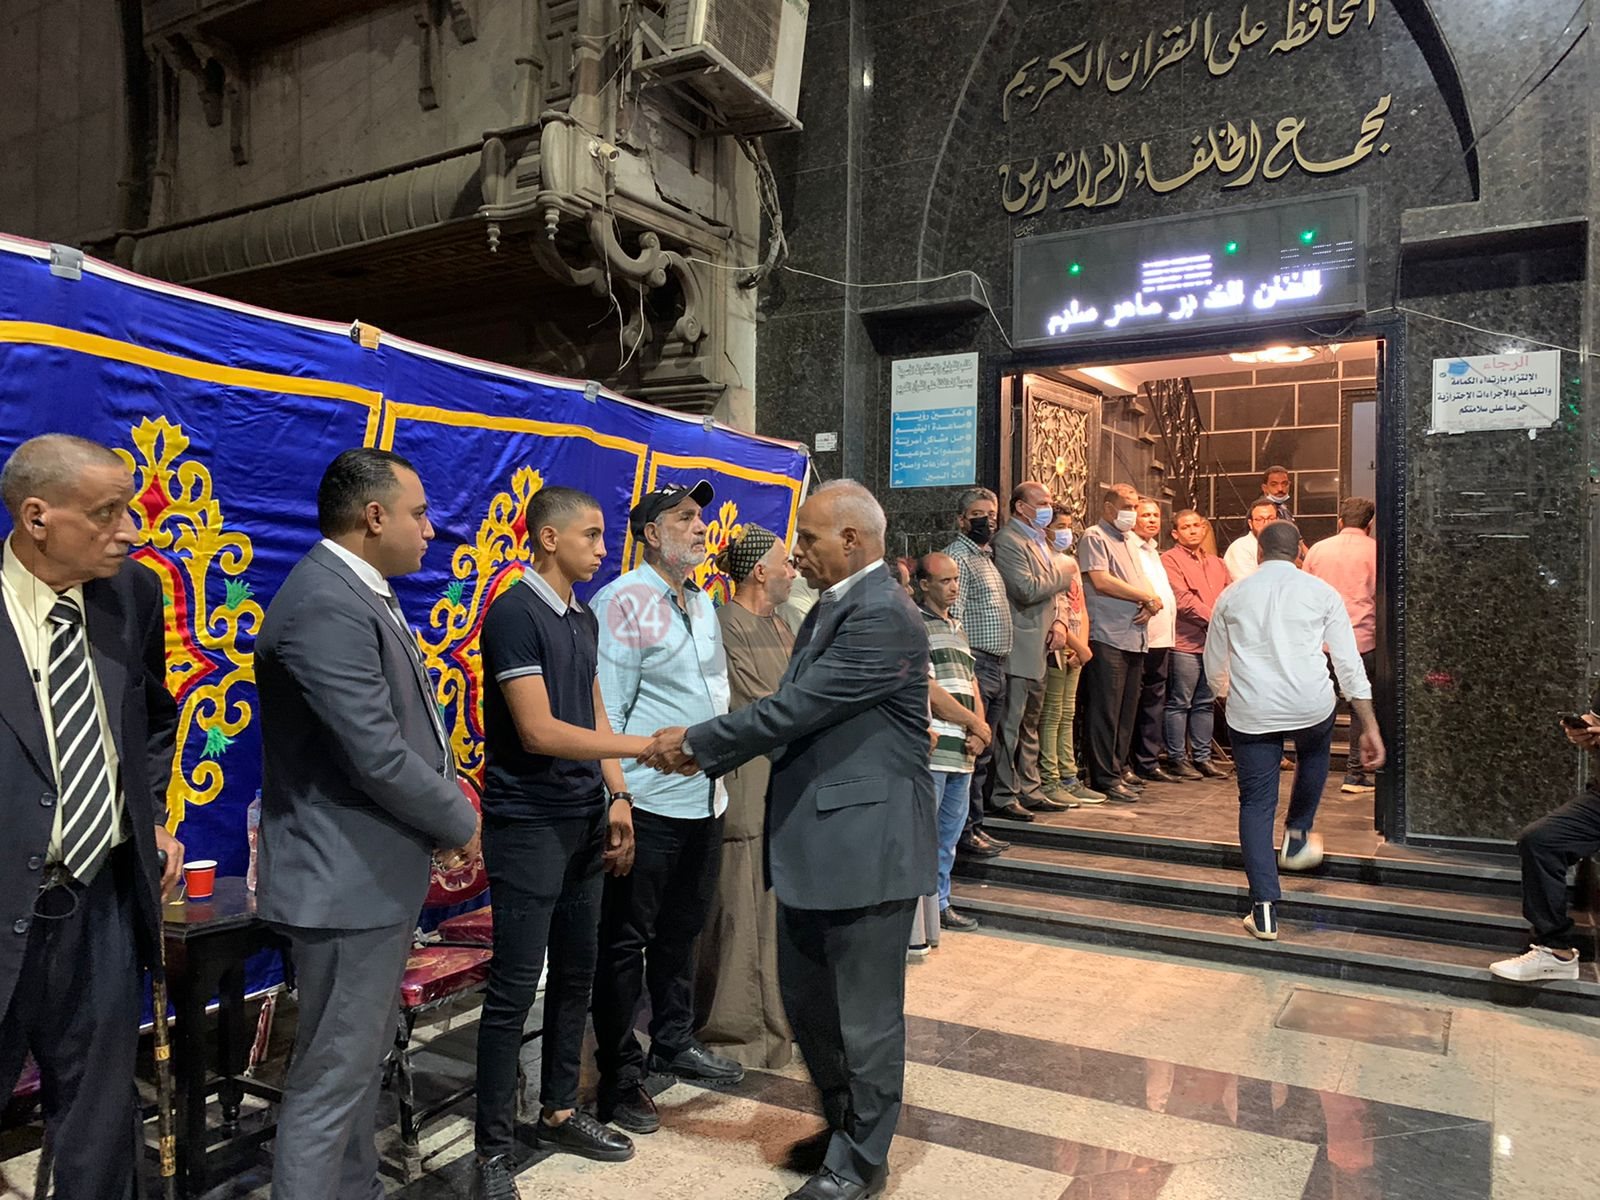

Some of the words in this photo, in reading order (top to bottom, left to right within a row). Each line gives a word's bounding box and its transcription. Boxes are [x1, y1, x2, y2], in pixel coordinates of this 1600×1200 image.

[1209, 4, 1268, 76] على
[1002, 36, 1105, 122] الكريم
[1263, 93, 1392, 179] مجمع
[1134, 119, 1262, 193] الخلفاء
[998, 141, 1129, 215] الراشدين
[1104, 292, 1162, 327] ماهر
[1451, 376, 1478, 385] الكمامة
[1483, 355, 1529, 371] الرجاء
[1489, 405, 1504, 413] على
[1518, 387, 1551, 397] والتباعد
[1459, 405, 1488, 415] سلامتكم
